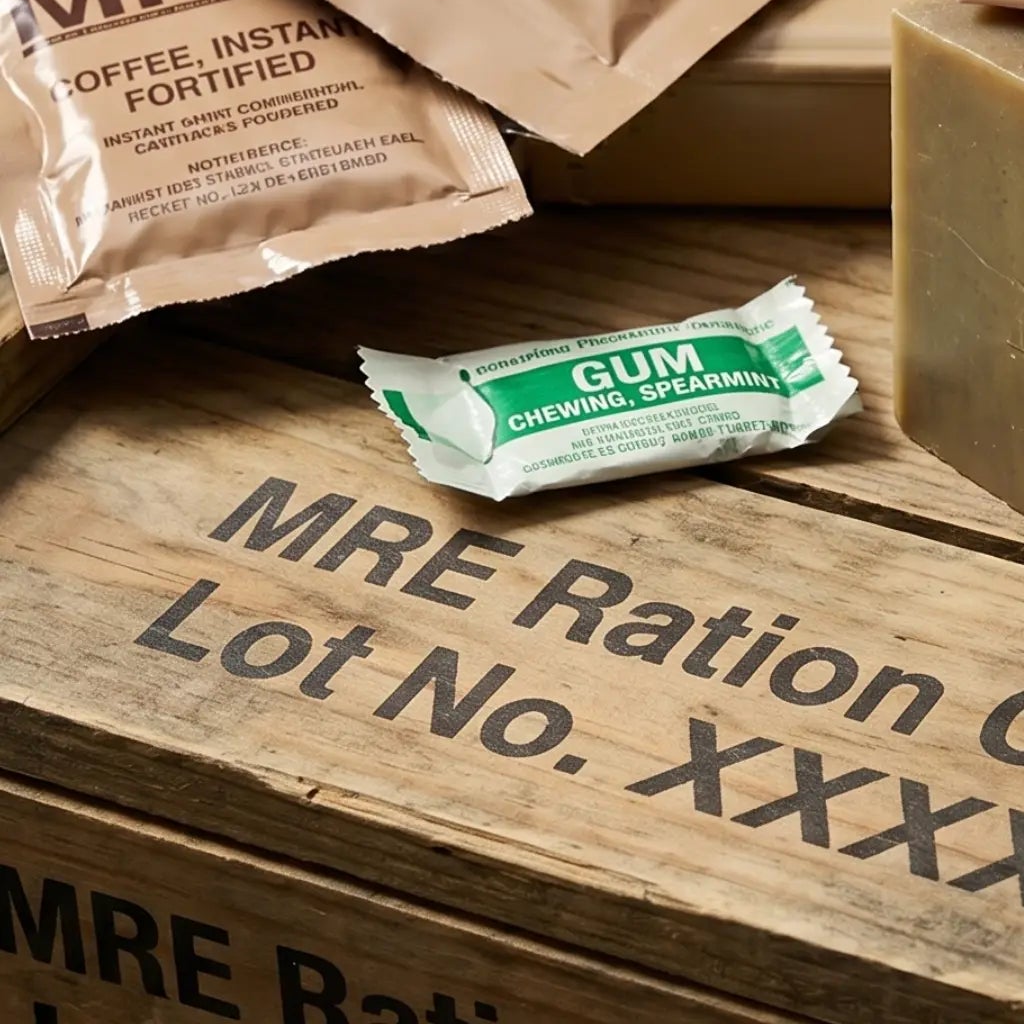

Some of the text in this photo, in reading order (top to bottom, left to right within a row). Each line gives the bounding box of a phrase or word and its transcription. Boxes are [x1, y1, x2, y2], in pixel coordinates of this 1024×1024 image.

[123, 49, 317, 114] FORTIFIED
[102, 120, 177, 149] INSTANT
[570, 342, 705, 394] GUM
[507, 391, 636, 434] CHEWING,
[640, 371, 783, 404] SPEARMINT
[207, 479, 526, 612] MRE
[512, 559, 946, 736] Ration
[131, 579, 376, 701] Lot
[375, 644, 591, 775] No.
[0, 863, 241, 1021] MRE
